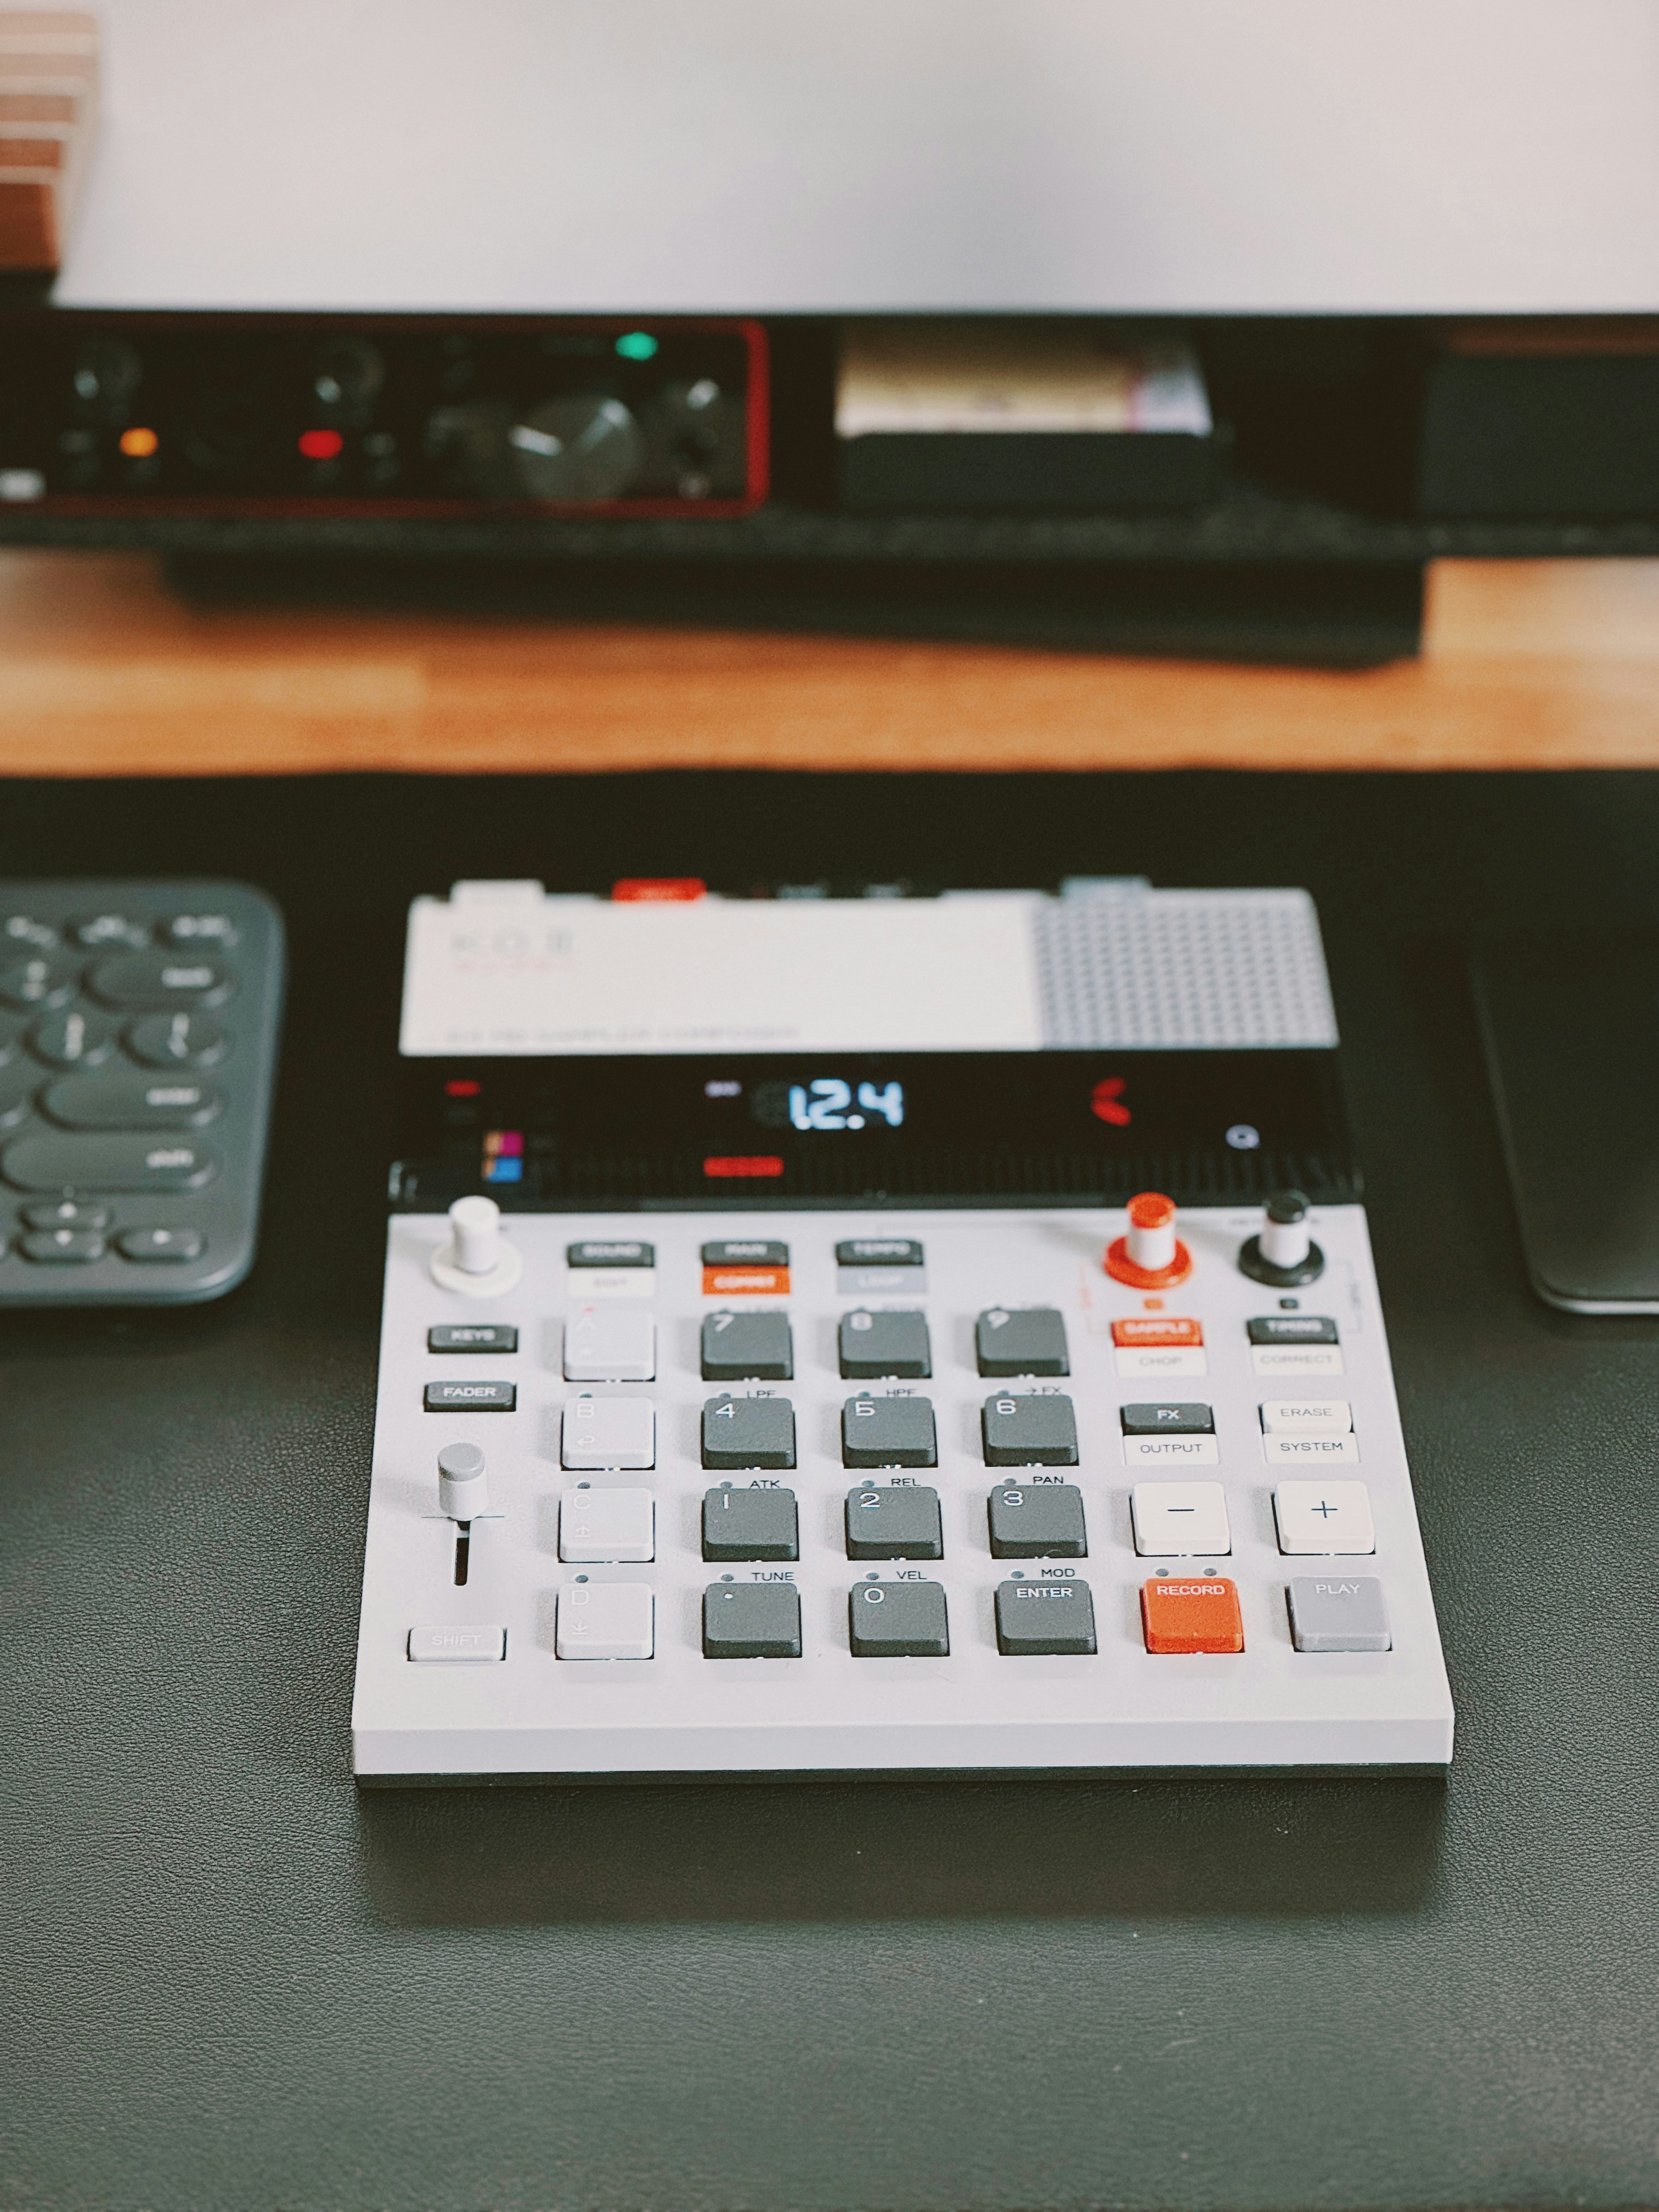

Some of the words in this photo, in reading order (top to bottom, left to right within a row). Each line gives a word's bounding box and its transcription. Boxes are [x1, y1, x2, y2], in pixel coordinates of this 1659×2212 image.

[713, 1314, 734, 1331] 7
[1124, 1321, 1191, 1334] SAMPLE
[451, 1329, 495, 1341] KEYS
[1139, 1356, 1183, 1366] CHOP
[1260, 1355, 1333, 1364] CORRECT
[443, 1387, 496, 1397] FADER
[886, 1388, 916, 1397] HPF
[577, 1403, 595, 1418] B
[715, 1403, 735, 1418] 4
[855, 1401, 875, 1416] 5
[996, 1399, 1017, 1414] 6
[1157, 1409, 1180, 1420] FX
[1281, 1408, 1333, 1417] ERASE
[1141, 1443, 1203, 1454] OUTPUT
[1280, 1442, 1344, 1452] SYSTEM
[749, 1480, 780, 1488] ATK
[891, 1479, 921, 1487] REL
[1033, 1476, 1064, 1485] PAN
[573, 1494, 592, 1510] C
[724, 1493, 729, 1509] 1
[860, 1493, 880, 1508] 2
[1003, 1491, 1024, 1506] 3
[752, 1572, 794, 1581] TUNE
[896, 1571, 927, 1580] VEL
[1041, 1568, 1075, 1577] MOD
[1017, 1588, 1073, 1598] ENTER
[1156, 1584, 1226, 1595] RECORD
[1316, 1584, 1361, 1594] PLAY
[571, 1589, 589, 1605] D
[431, 1635, 481, 1646] SHIFT
